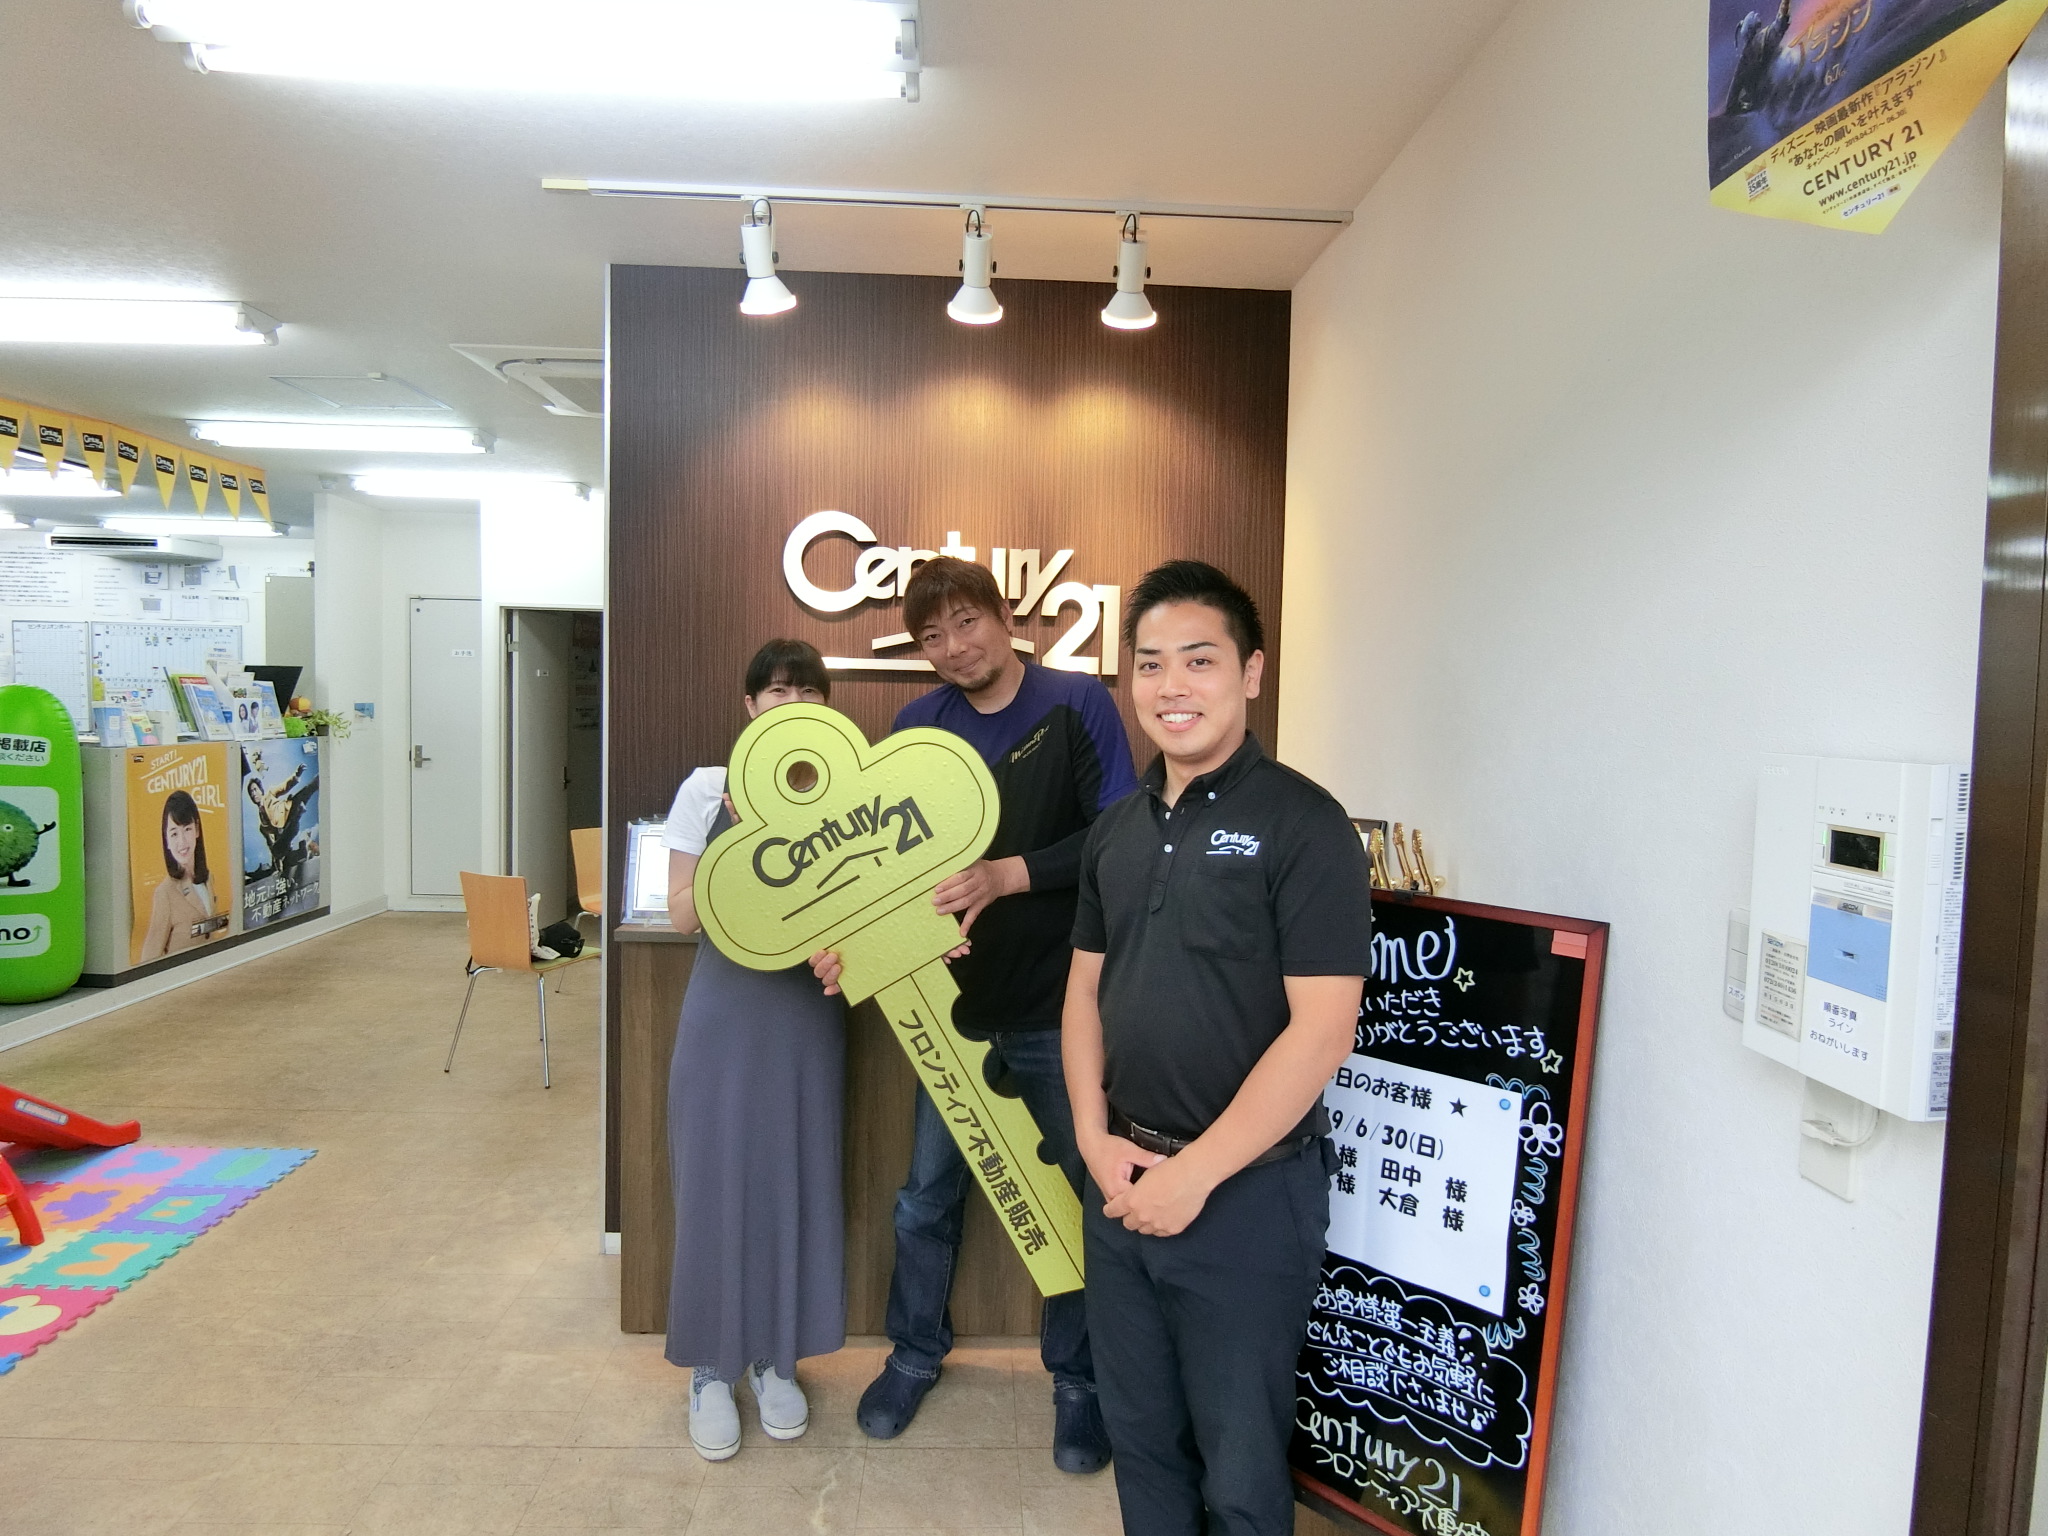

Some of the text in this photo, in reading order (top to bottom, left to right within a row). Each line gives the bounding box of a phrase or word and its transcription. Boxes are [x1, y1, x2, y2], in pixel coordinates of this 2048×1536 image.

[1770, 48, 1947, 163] ディズニー映画最新作『アラジン』
[1802, 119, 1925, 196] CENTURY 21
[1806, 146, 1841, 171] キャンペーン
[1818, 150, 1917, 207] www.century21.jp
[1041, 581, 1120, 675] 21
[150, 748, 177, 770] START!
[191, 784, 225, 808] GIRL
[752, 795, 934, 888] Century 21
[1210, 829, 1260, 856] Century 21
[1822, 1001, 1858, 1022] 順番写真
[1828, 1017, 1854, 1034] ライン
[1810, 1029, 1869, 1062] おねがいします
[1331, 1065, 1432, 1110] 日のお客様
[898, 1008, 1048, 1256] フロンティア不動産販売
[1339, 1144, 1467, 1203] 様 田中 様
[1336, 1171, 1465, 1232] 様 大倉 様
[1307, 1320, 1496, 1406] どんなことでもお気軽に
[1418, 1458, 1460, 1511] 21
